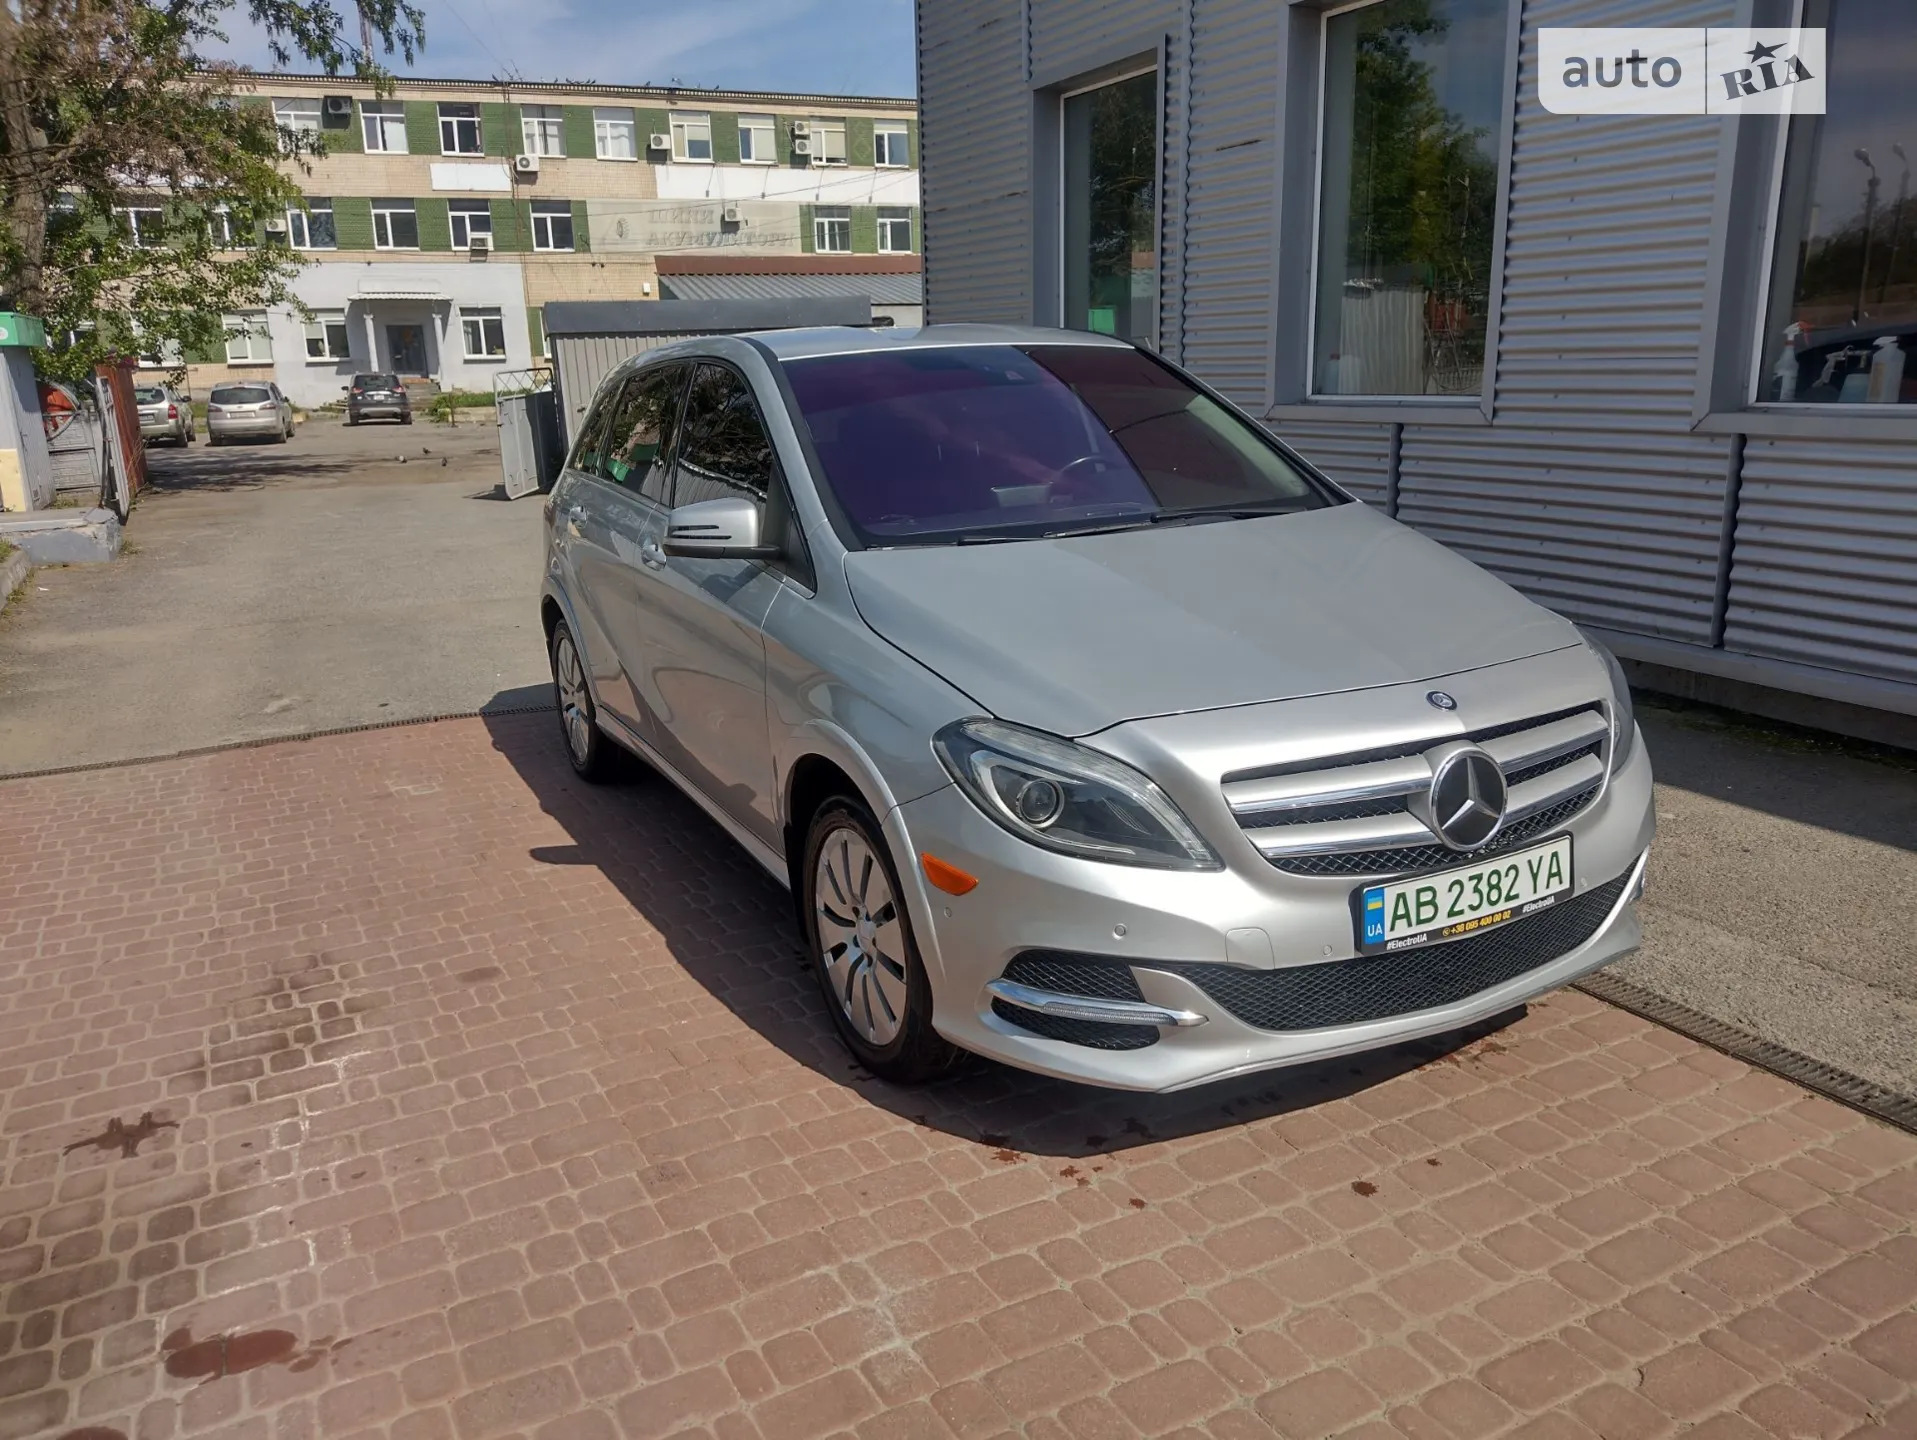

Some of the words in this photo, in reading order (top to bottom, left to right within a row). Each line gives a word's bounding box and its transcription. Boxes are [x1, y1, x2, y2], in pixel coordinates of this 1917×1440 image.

[1389, 885, 1439, 933] AB
[1447, 864, 1520, 919] 2382
[1527, 851, 1564, 895] YA
[1367, 922, 1383, 937] UA
[1450, 923, 1465, 936] +38
[1386, 933, 1428, 951] #ElectroUA
